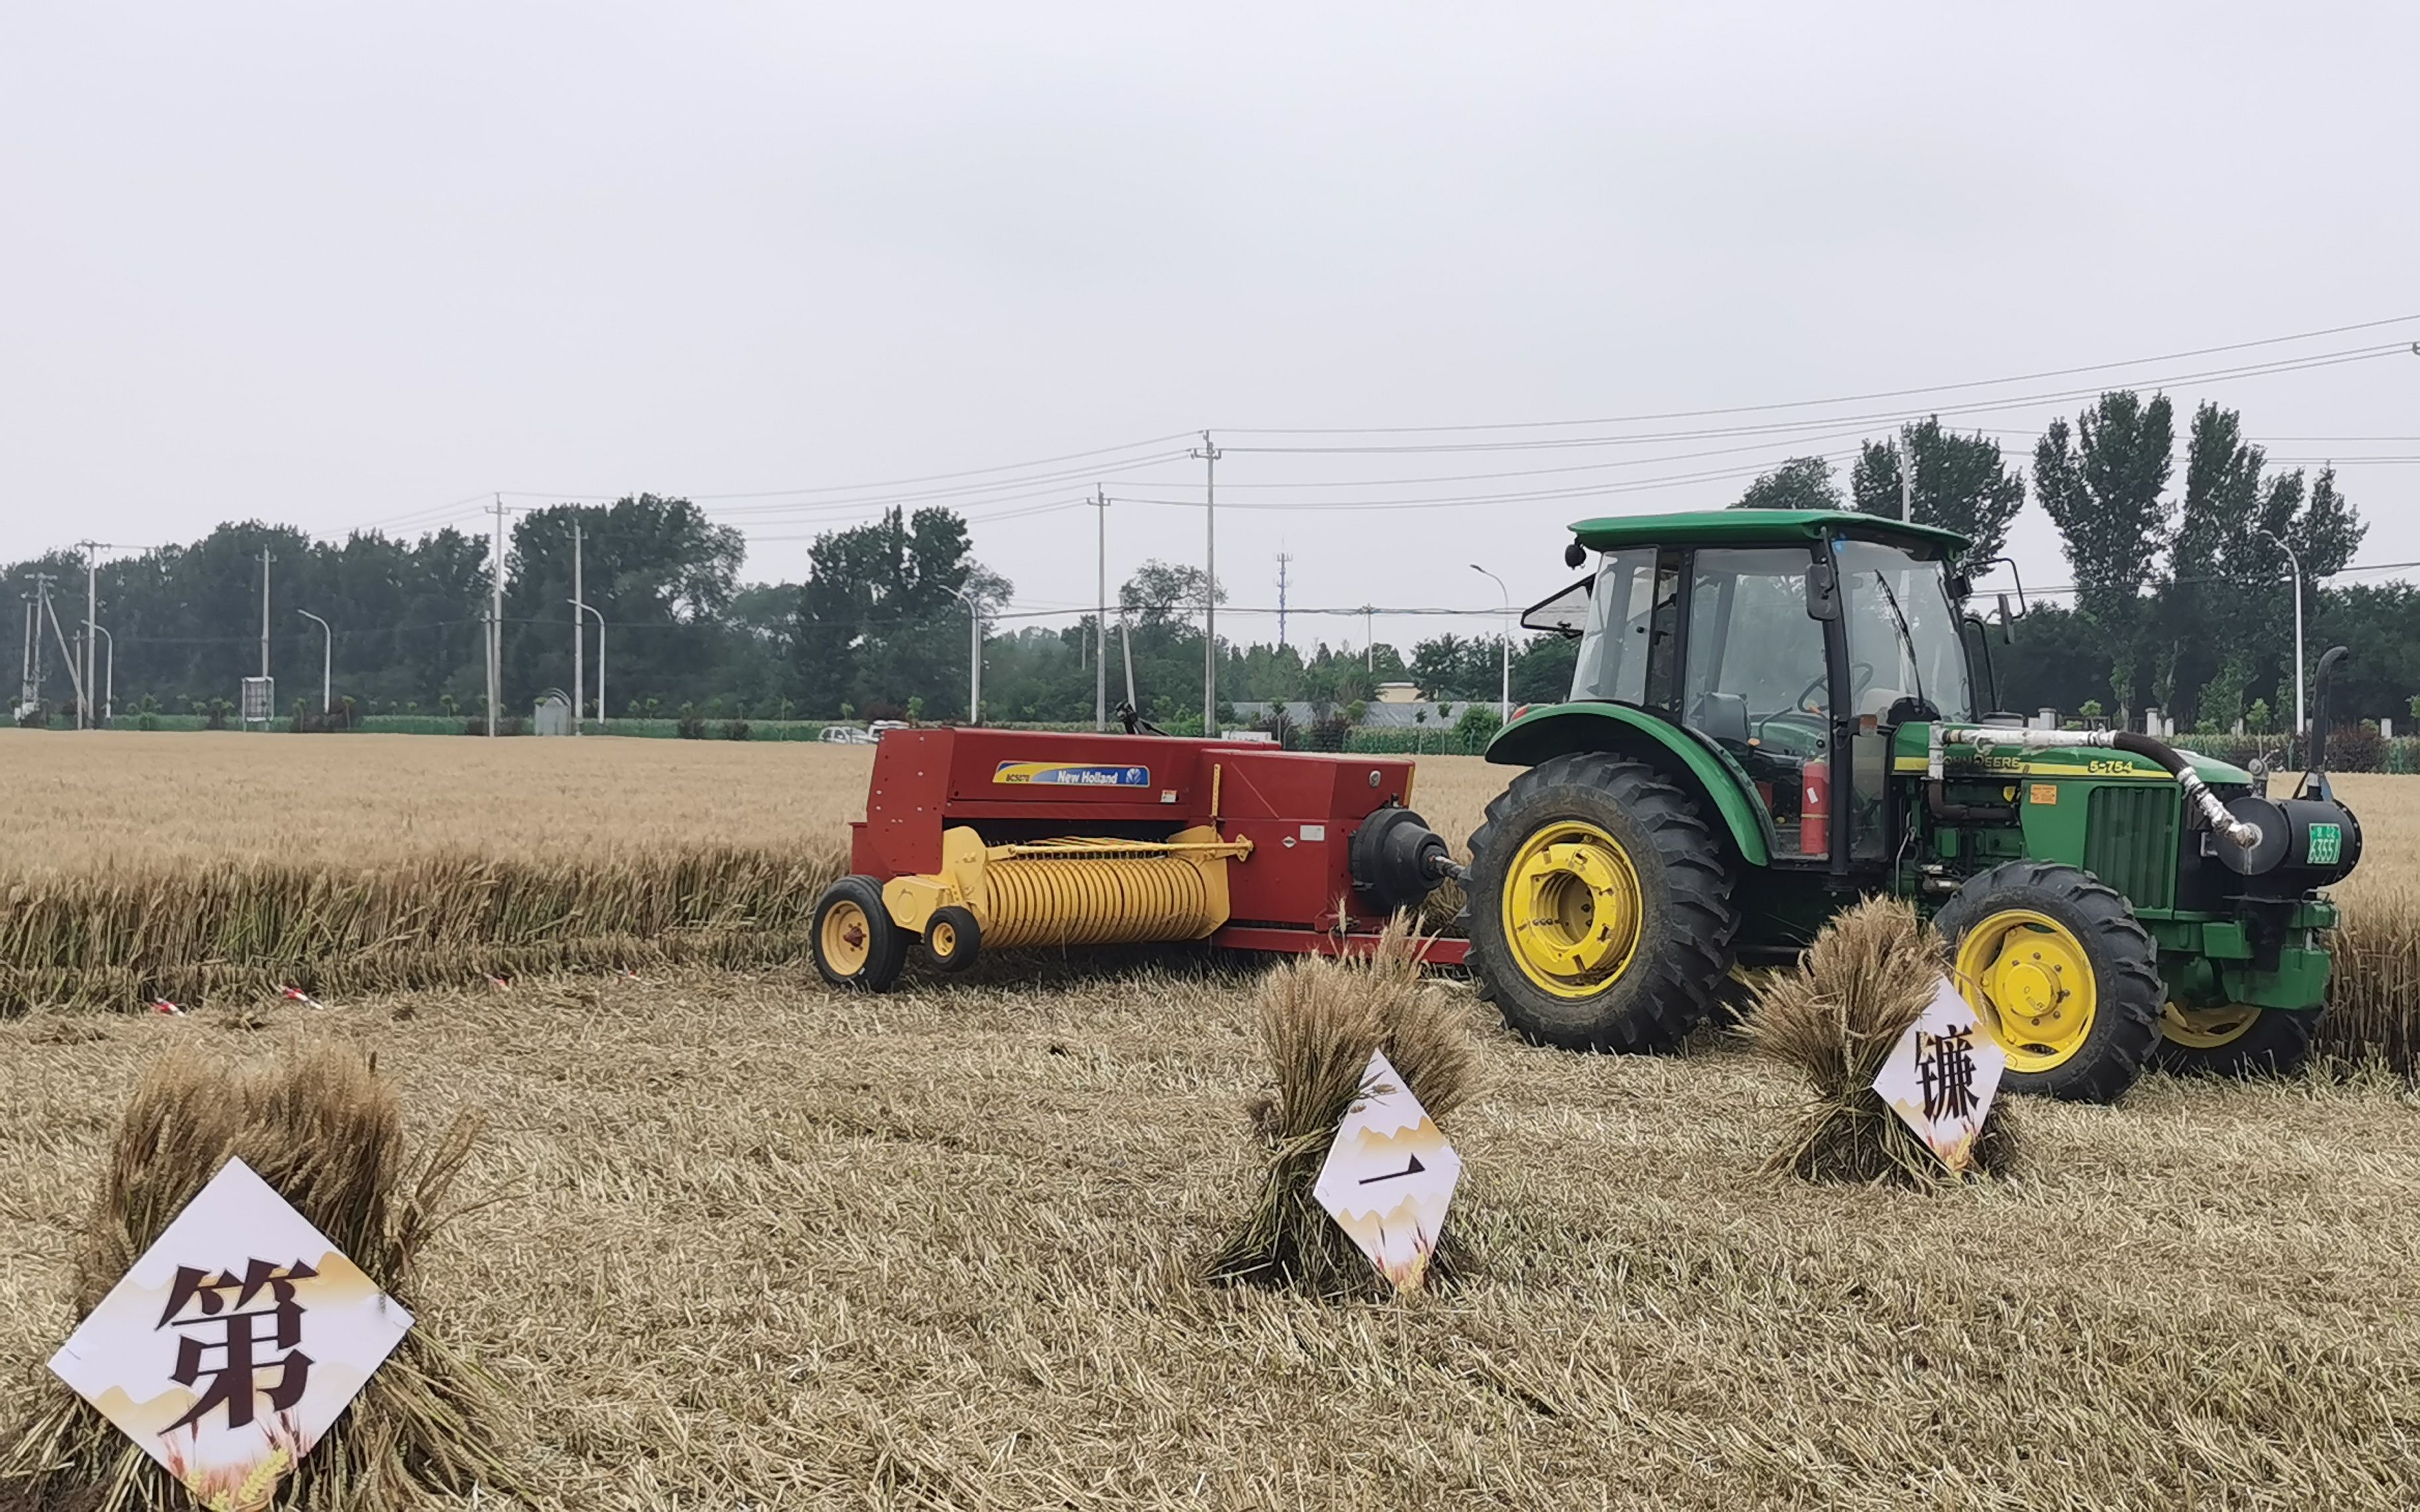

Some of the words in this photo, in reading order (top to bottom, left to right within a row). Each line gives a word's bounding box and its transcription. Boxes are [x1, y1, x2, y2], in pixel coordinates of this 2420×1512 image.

[1974, 753, 2021, 768] DEERE
[2088, 760, 2133, 773] 5-754
[1057, 770, 1080, 783] New
[1082, 771, 1118, 784] Holland
[1915, 1024, 1980, 1125] 镰
[1359, 1152, 1426, 1185] 一
[155, 1257, 320, 1436] 第
